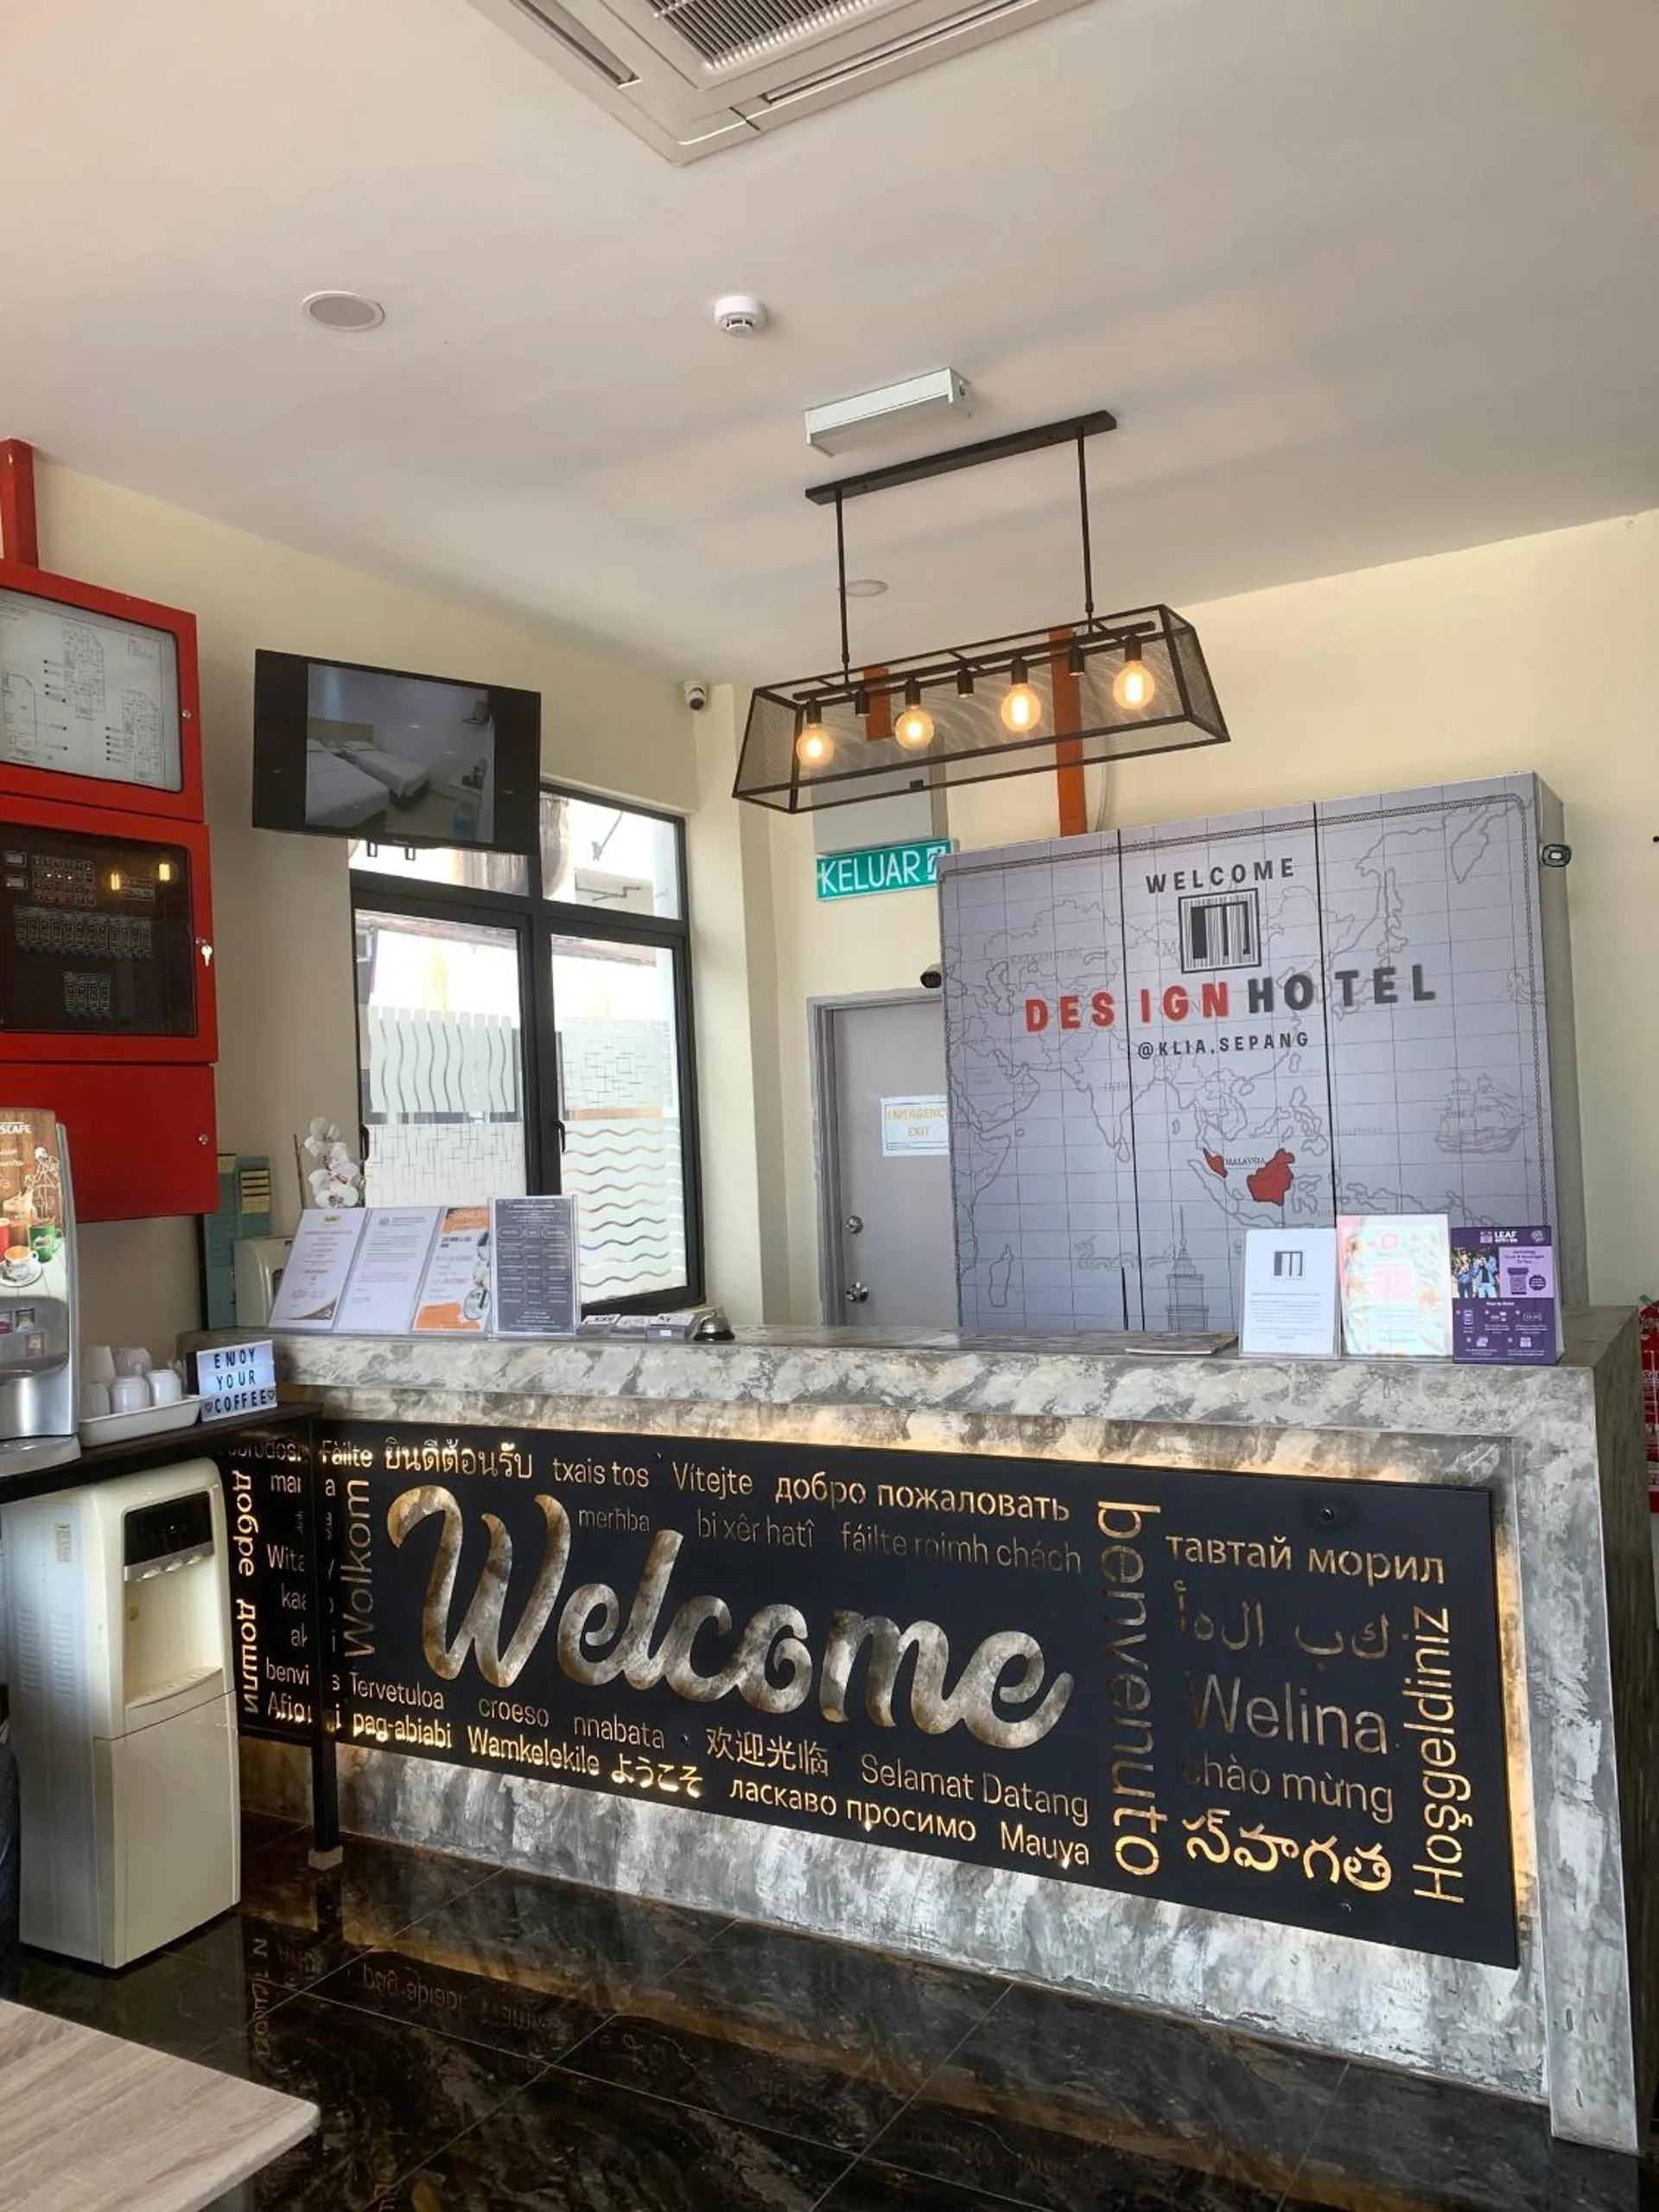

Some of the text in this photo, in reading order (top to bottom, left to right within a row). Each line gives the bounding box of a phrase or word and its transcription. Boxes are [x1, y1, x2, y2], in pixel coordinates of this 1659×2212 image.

[821, 850, 920, 893] KELUAR
[1146, 858, 1294, 893] WELCOME
[1248, 964, 1436, 1014] HOTEL
[1138, 1031, 1309, 1059] @KLIA.SEPANG
[887, 1108, 945, 1121] EMERGENC
[908, 1127, 931, 1137] EXIT
[1225, 1157, 1266, 1166] MALAYSIA
[214, 1389, 267, 1414] COFFEE
[216, 1370, 256, 1391] YOUR
[385, 1435, 533, 1479] ยินดีต้อนรับ
[552, 1461, 650, 1487] txais tos
[672, 1462, 753, 1500] Vítejte
[775, 1471, 1071, 1522] добро пожаловать
[696, 1510, 816, 1549] bi xêr hatî
[841, 1521, 1083, 1574] fáilte roimh chách
[1165, 1534, 1445, 1586] тавтай морил
[386, 1484, 1075, 1750] Welcome
[350, 1672, 445, 1710] Tervetuloa
[1097, 1500, 1168, 1877] benvenuto
[353, 1712, 453, 1749] pag-abiabi
[478, 1696, 550, 1727] croeso
[574, 1713, 665, 1749] nnabata
[1184, 1670, 1387, 1755] Welina
[467, 1726, 601, 1777] Wamkelekile
[706, 1726, 830, 1778] 欢迎光临
[1402, 1605, 1473, 1904] Hoşgeldiniz
[610, 1754, 703, 1799] ようこそ
[861, 1752, 1090, 1827] Selamat Datang
[1183, 1752, 1272, 1796] chào
[729, 1778, 976, 1842] ласкаво просимо
[1001, 1821, 1090, 1870] Mauya
